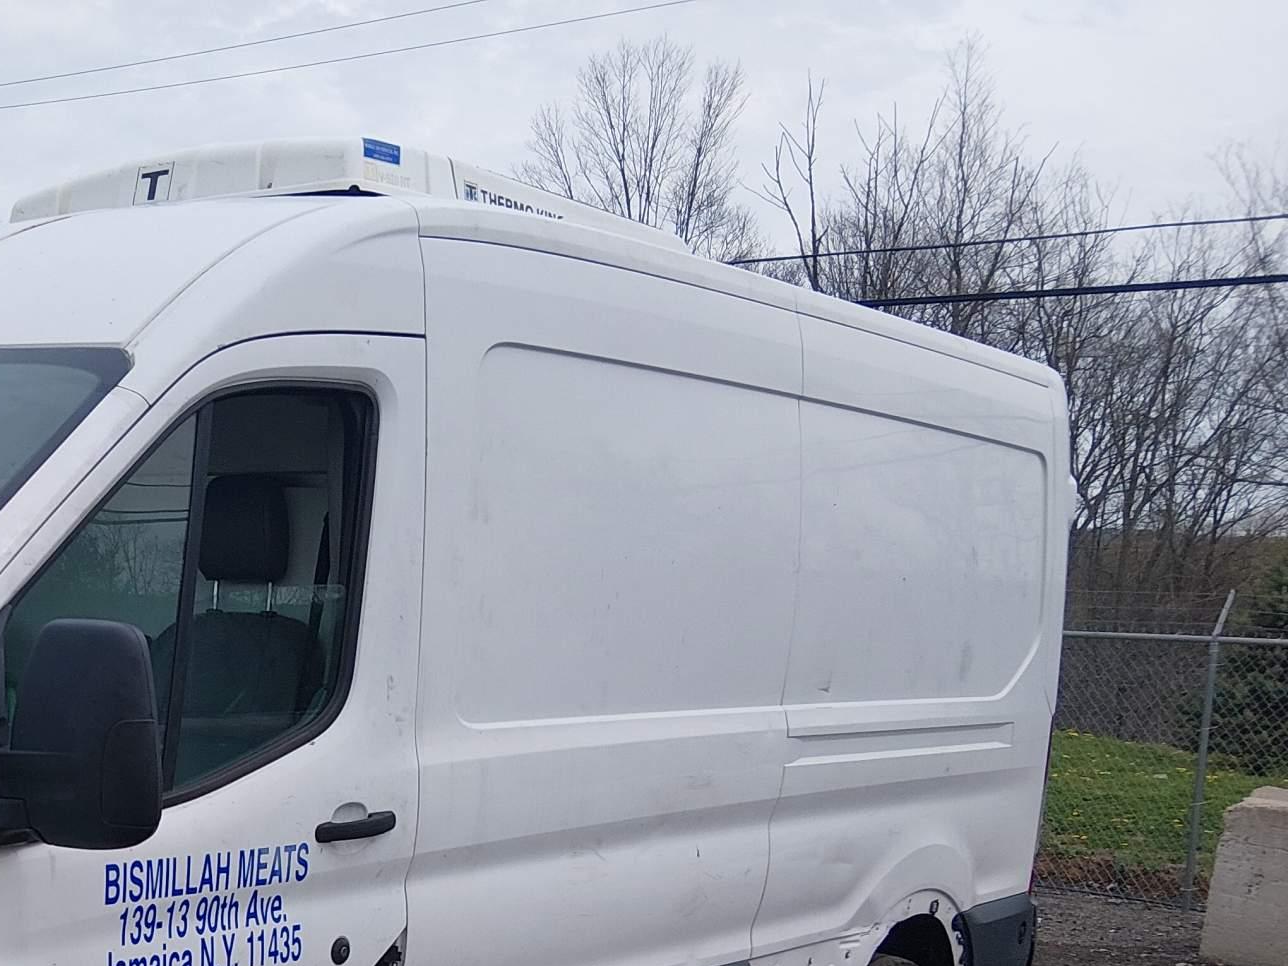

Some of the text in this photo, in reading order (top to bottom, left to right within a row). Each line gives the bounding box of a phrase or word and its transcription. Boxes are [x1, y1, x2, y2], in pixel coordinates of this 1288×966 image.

[104, 842, 310, 905] BISMILLAH MEATS
[119, 889, 287, 946] 139-13 90th Ave.
